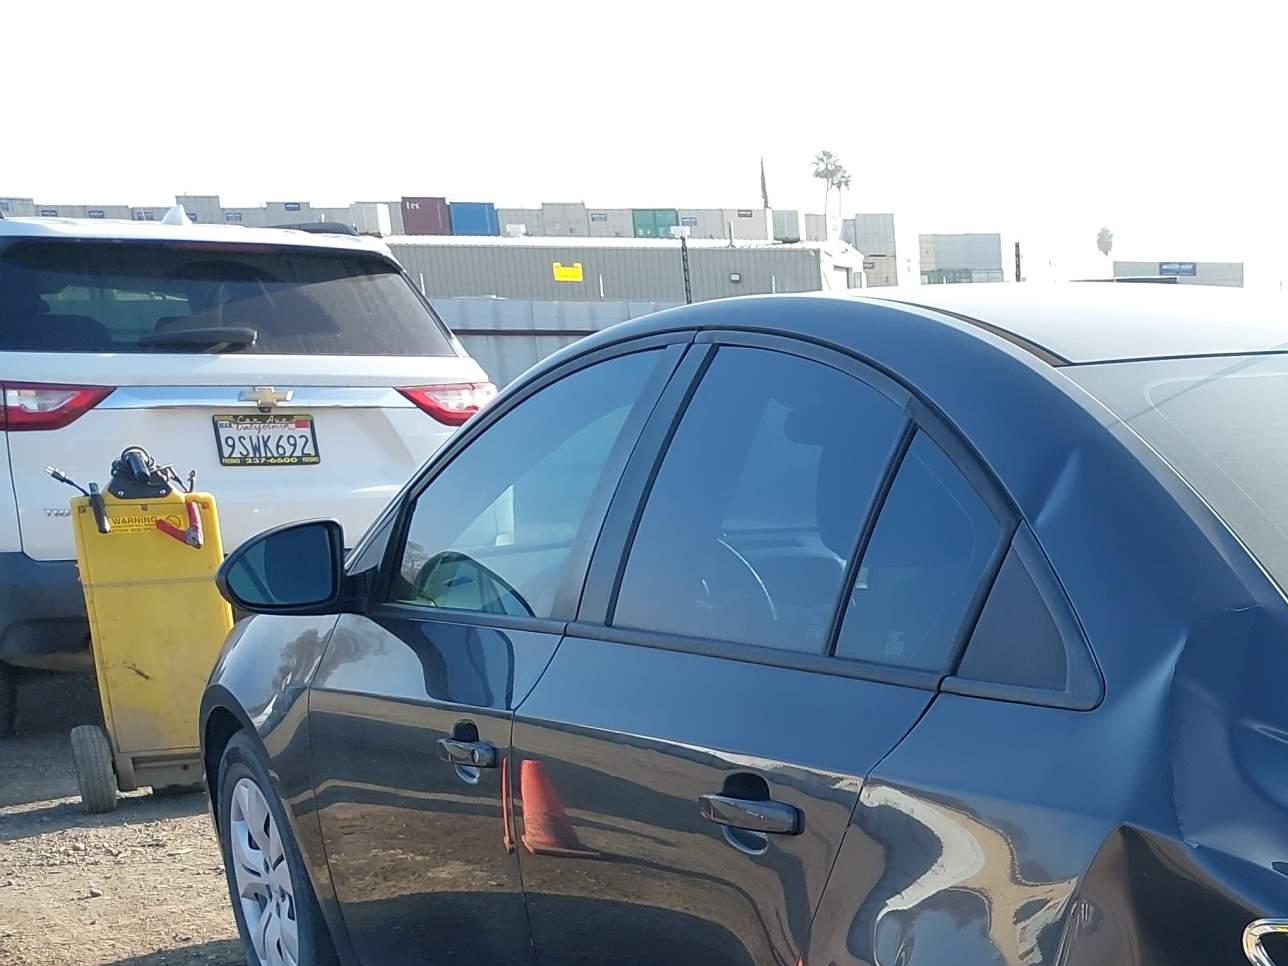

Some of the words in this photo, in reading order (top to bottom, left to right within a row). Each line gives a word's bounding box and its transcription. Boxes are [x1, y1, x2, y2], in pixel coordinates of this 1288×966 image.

[236, 422, 296, 434] California
[225, 434, 311, 457] 9SWK692
[112, 516, 157, 525] WARNING
